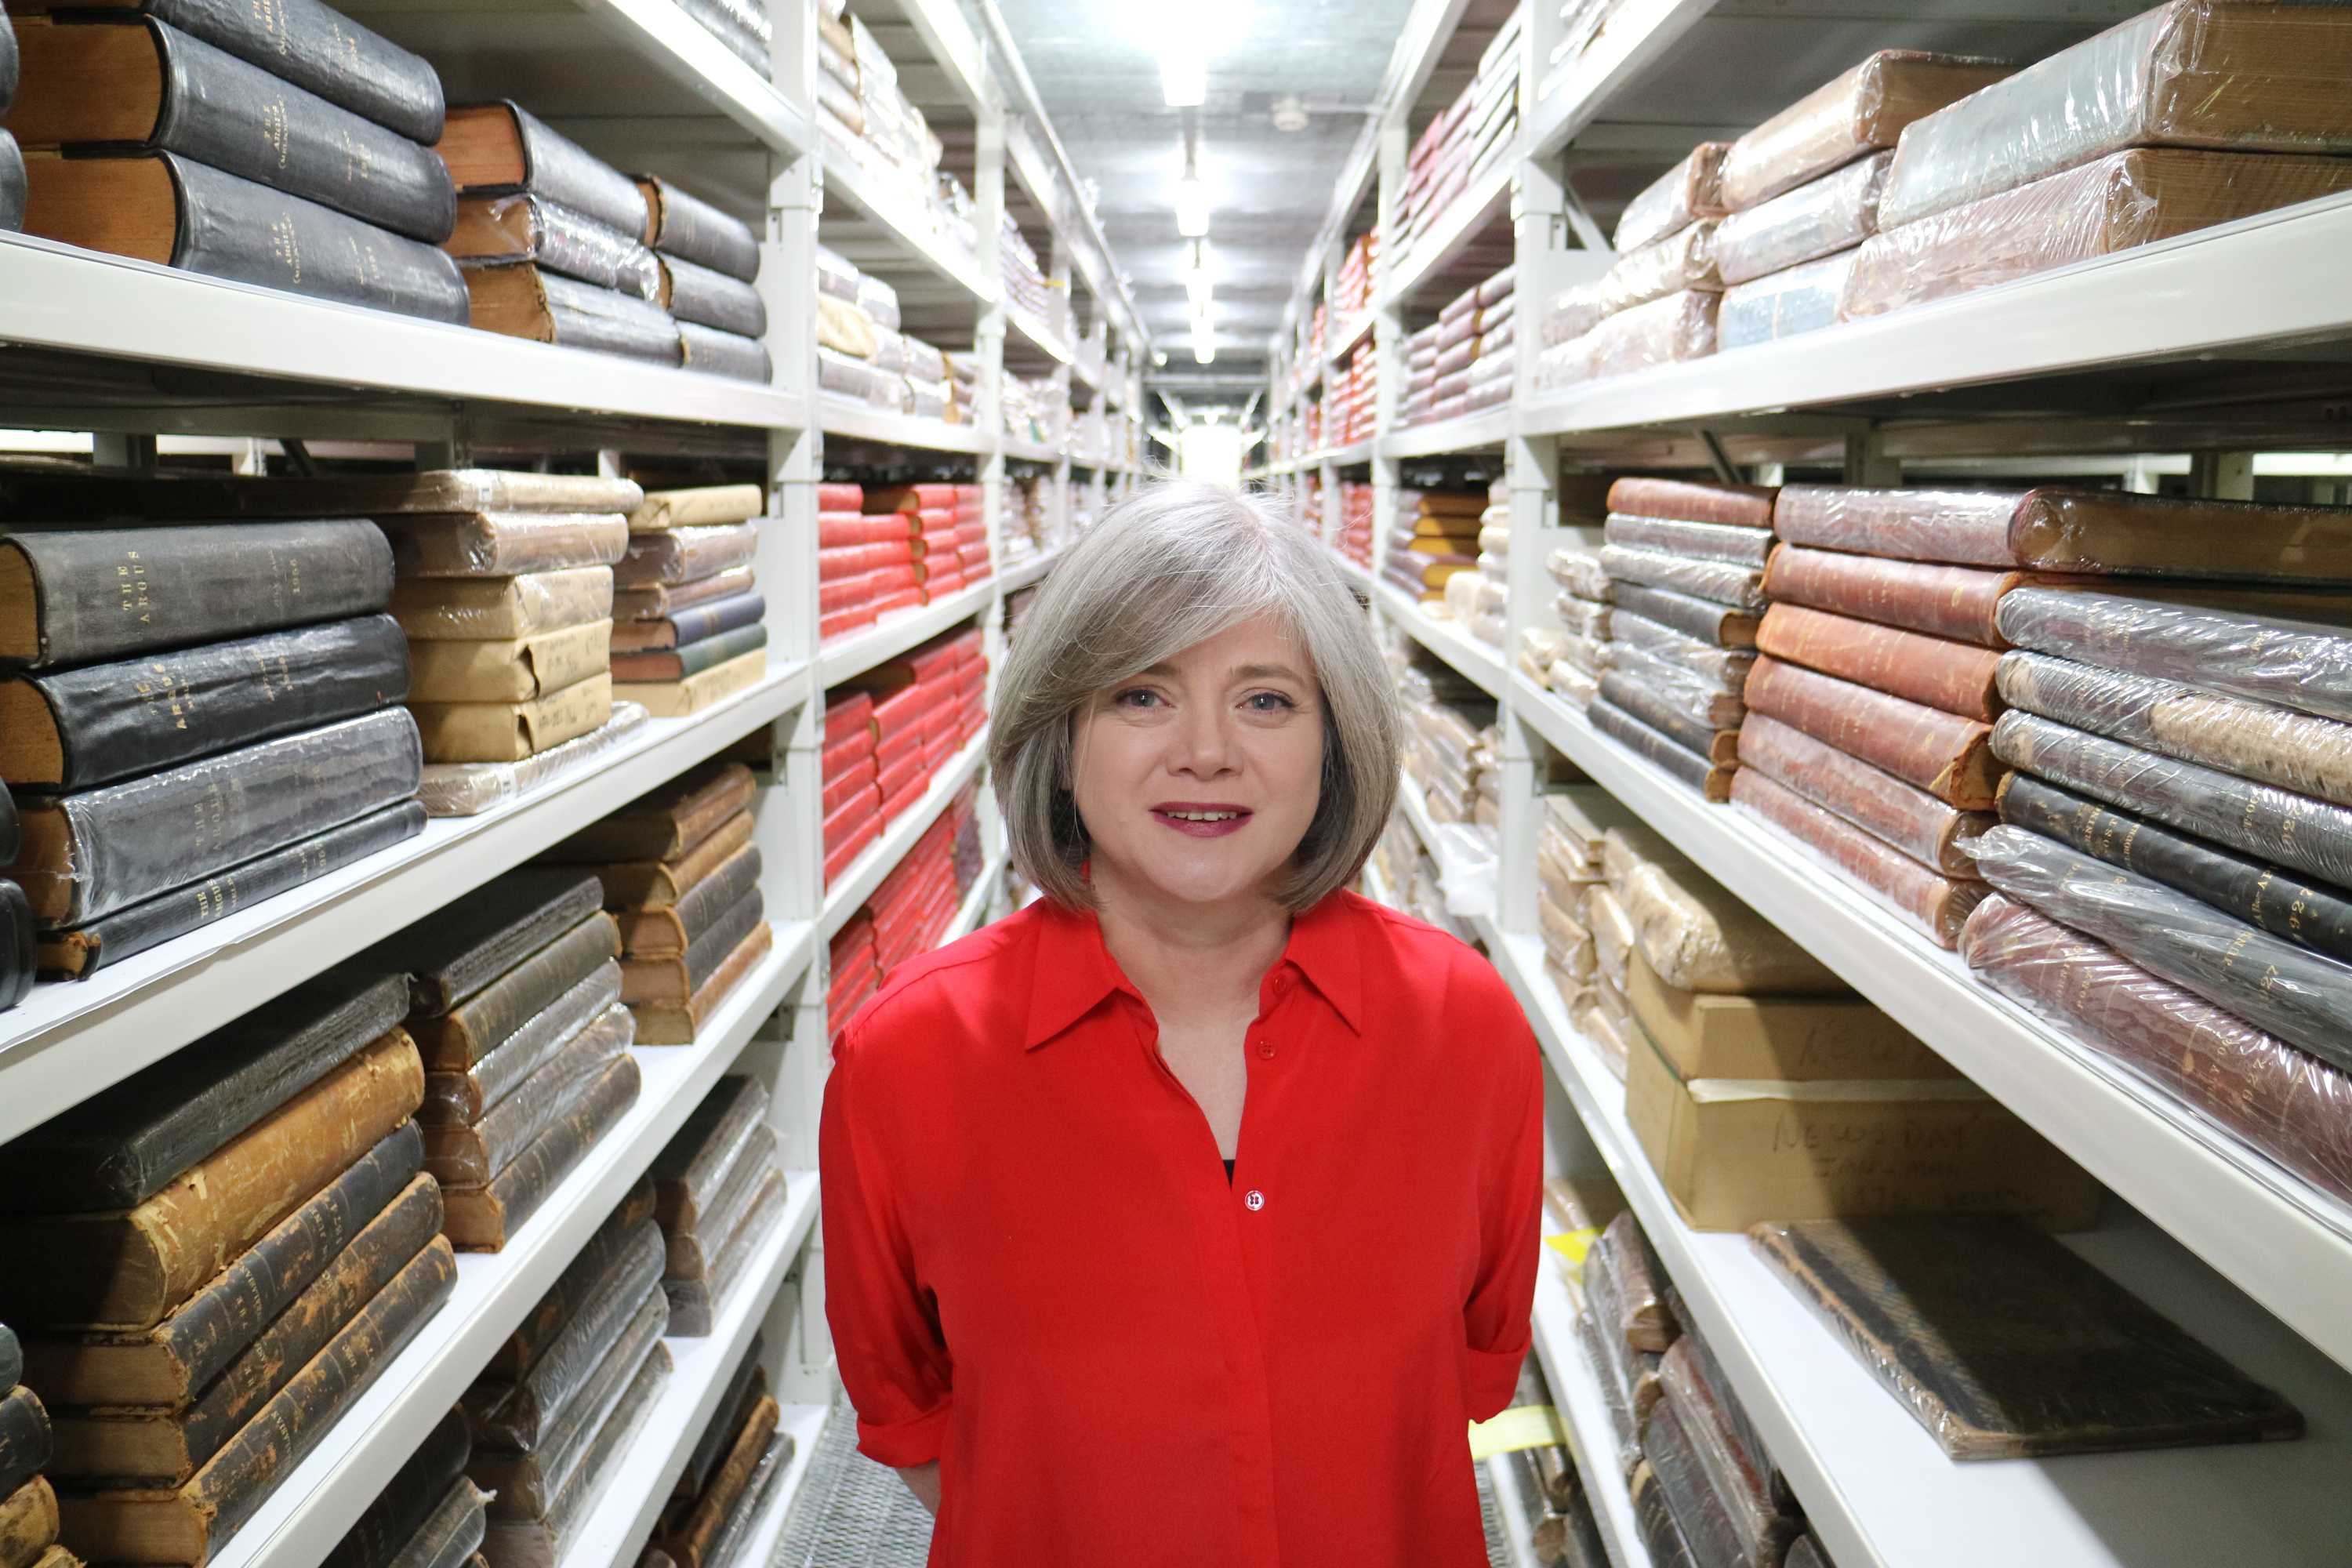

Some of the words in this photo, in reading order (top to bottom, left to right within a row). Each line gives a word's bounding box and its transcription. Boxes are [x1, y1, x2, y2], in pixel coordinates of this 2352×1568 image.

[118, 565, 132, 612] THE
[127, 550, 151, 624] ARGUS
[152, 663, 188, 730] ARGUS
[194, 802, 206, 847] THE
[198, 891, 209, 918] THE
[207, 878, 224, 918] ARGUS
